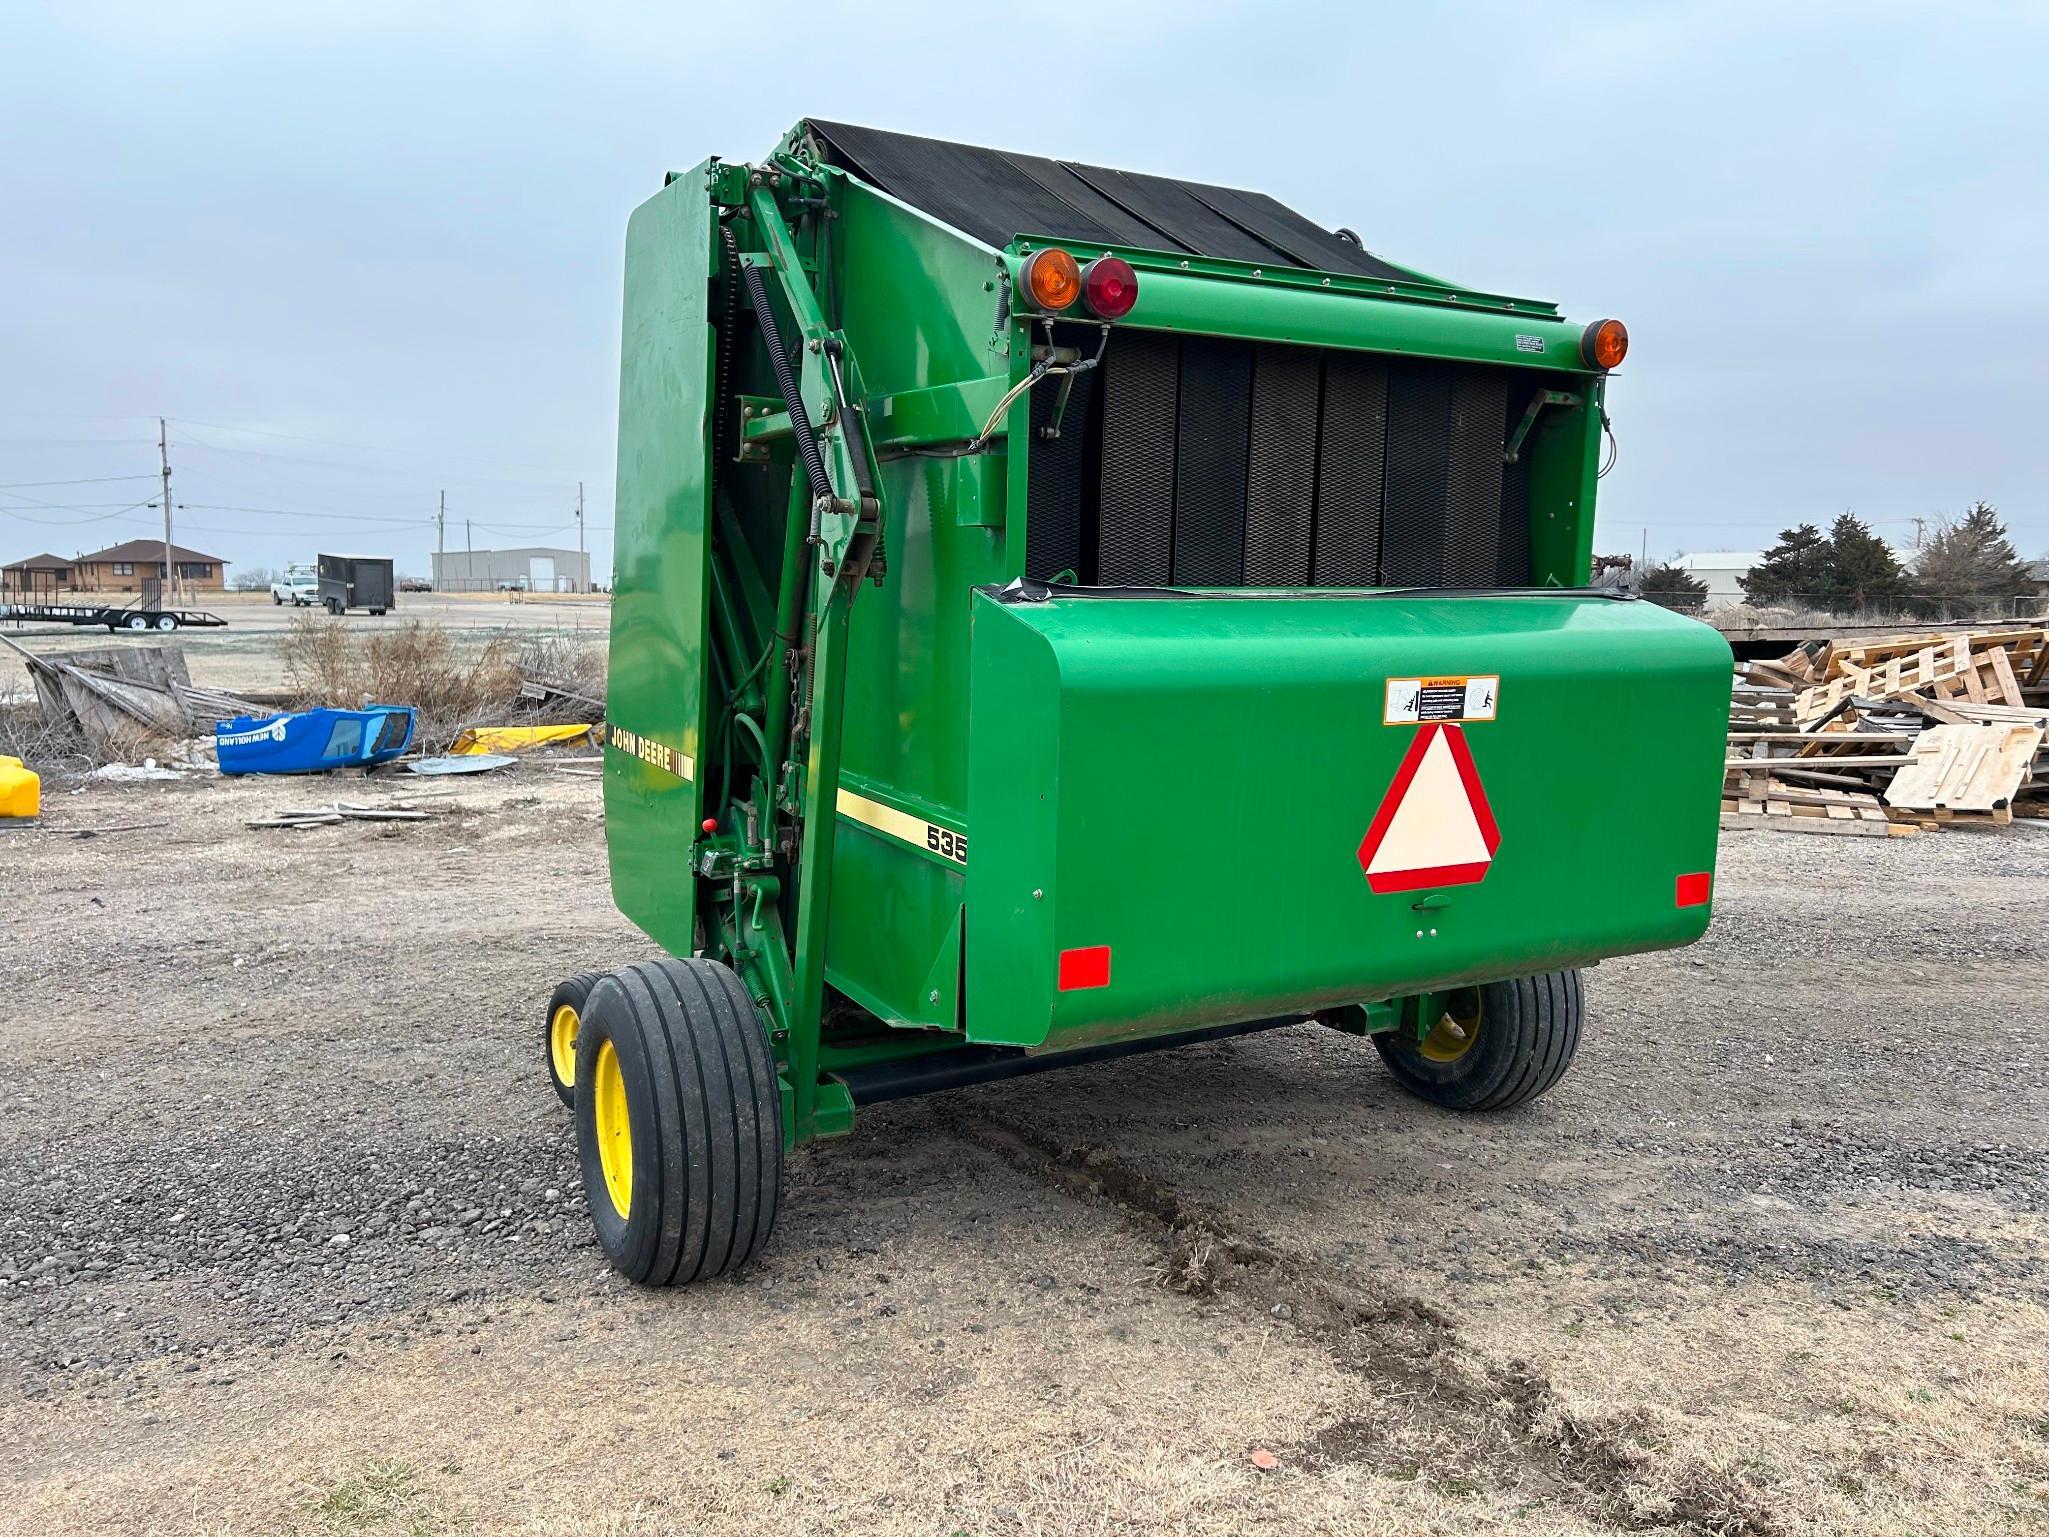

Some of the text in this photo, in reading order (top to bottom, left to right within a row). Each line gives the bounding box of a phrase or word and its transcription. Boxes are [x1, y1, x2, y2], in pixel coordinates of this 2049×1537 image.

[219, 732, 269, 746] NEW HOLLAND
[611, 726, 671, 770] JOHN DEERE
[927, 825, 967, 863] 535
